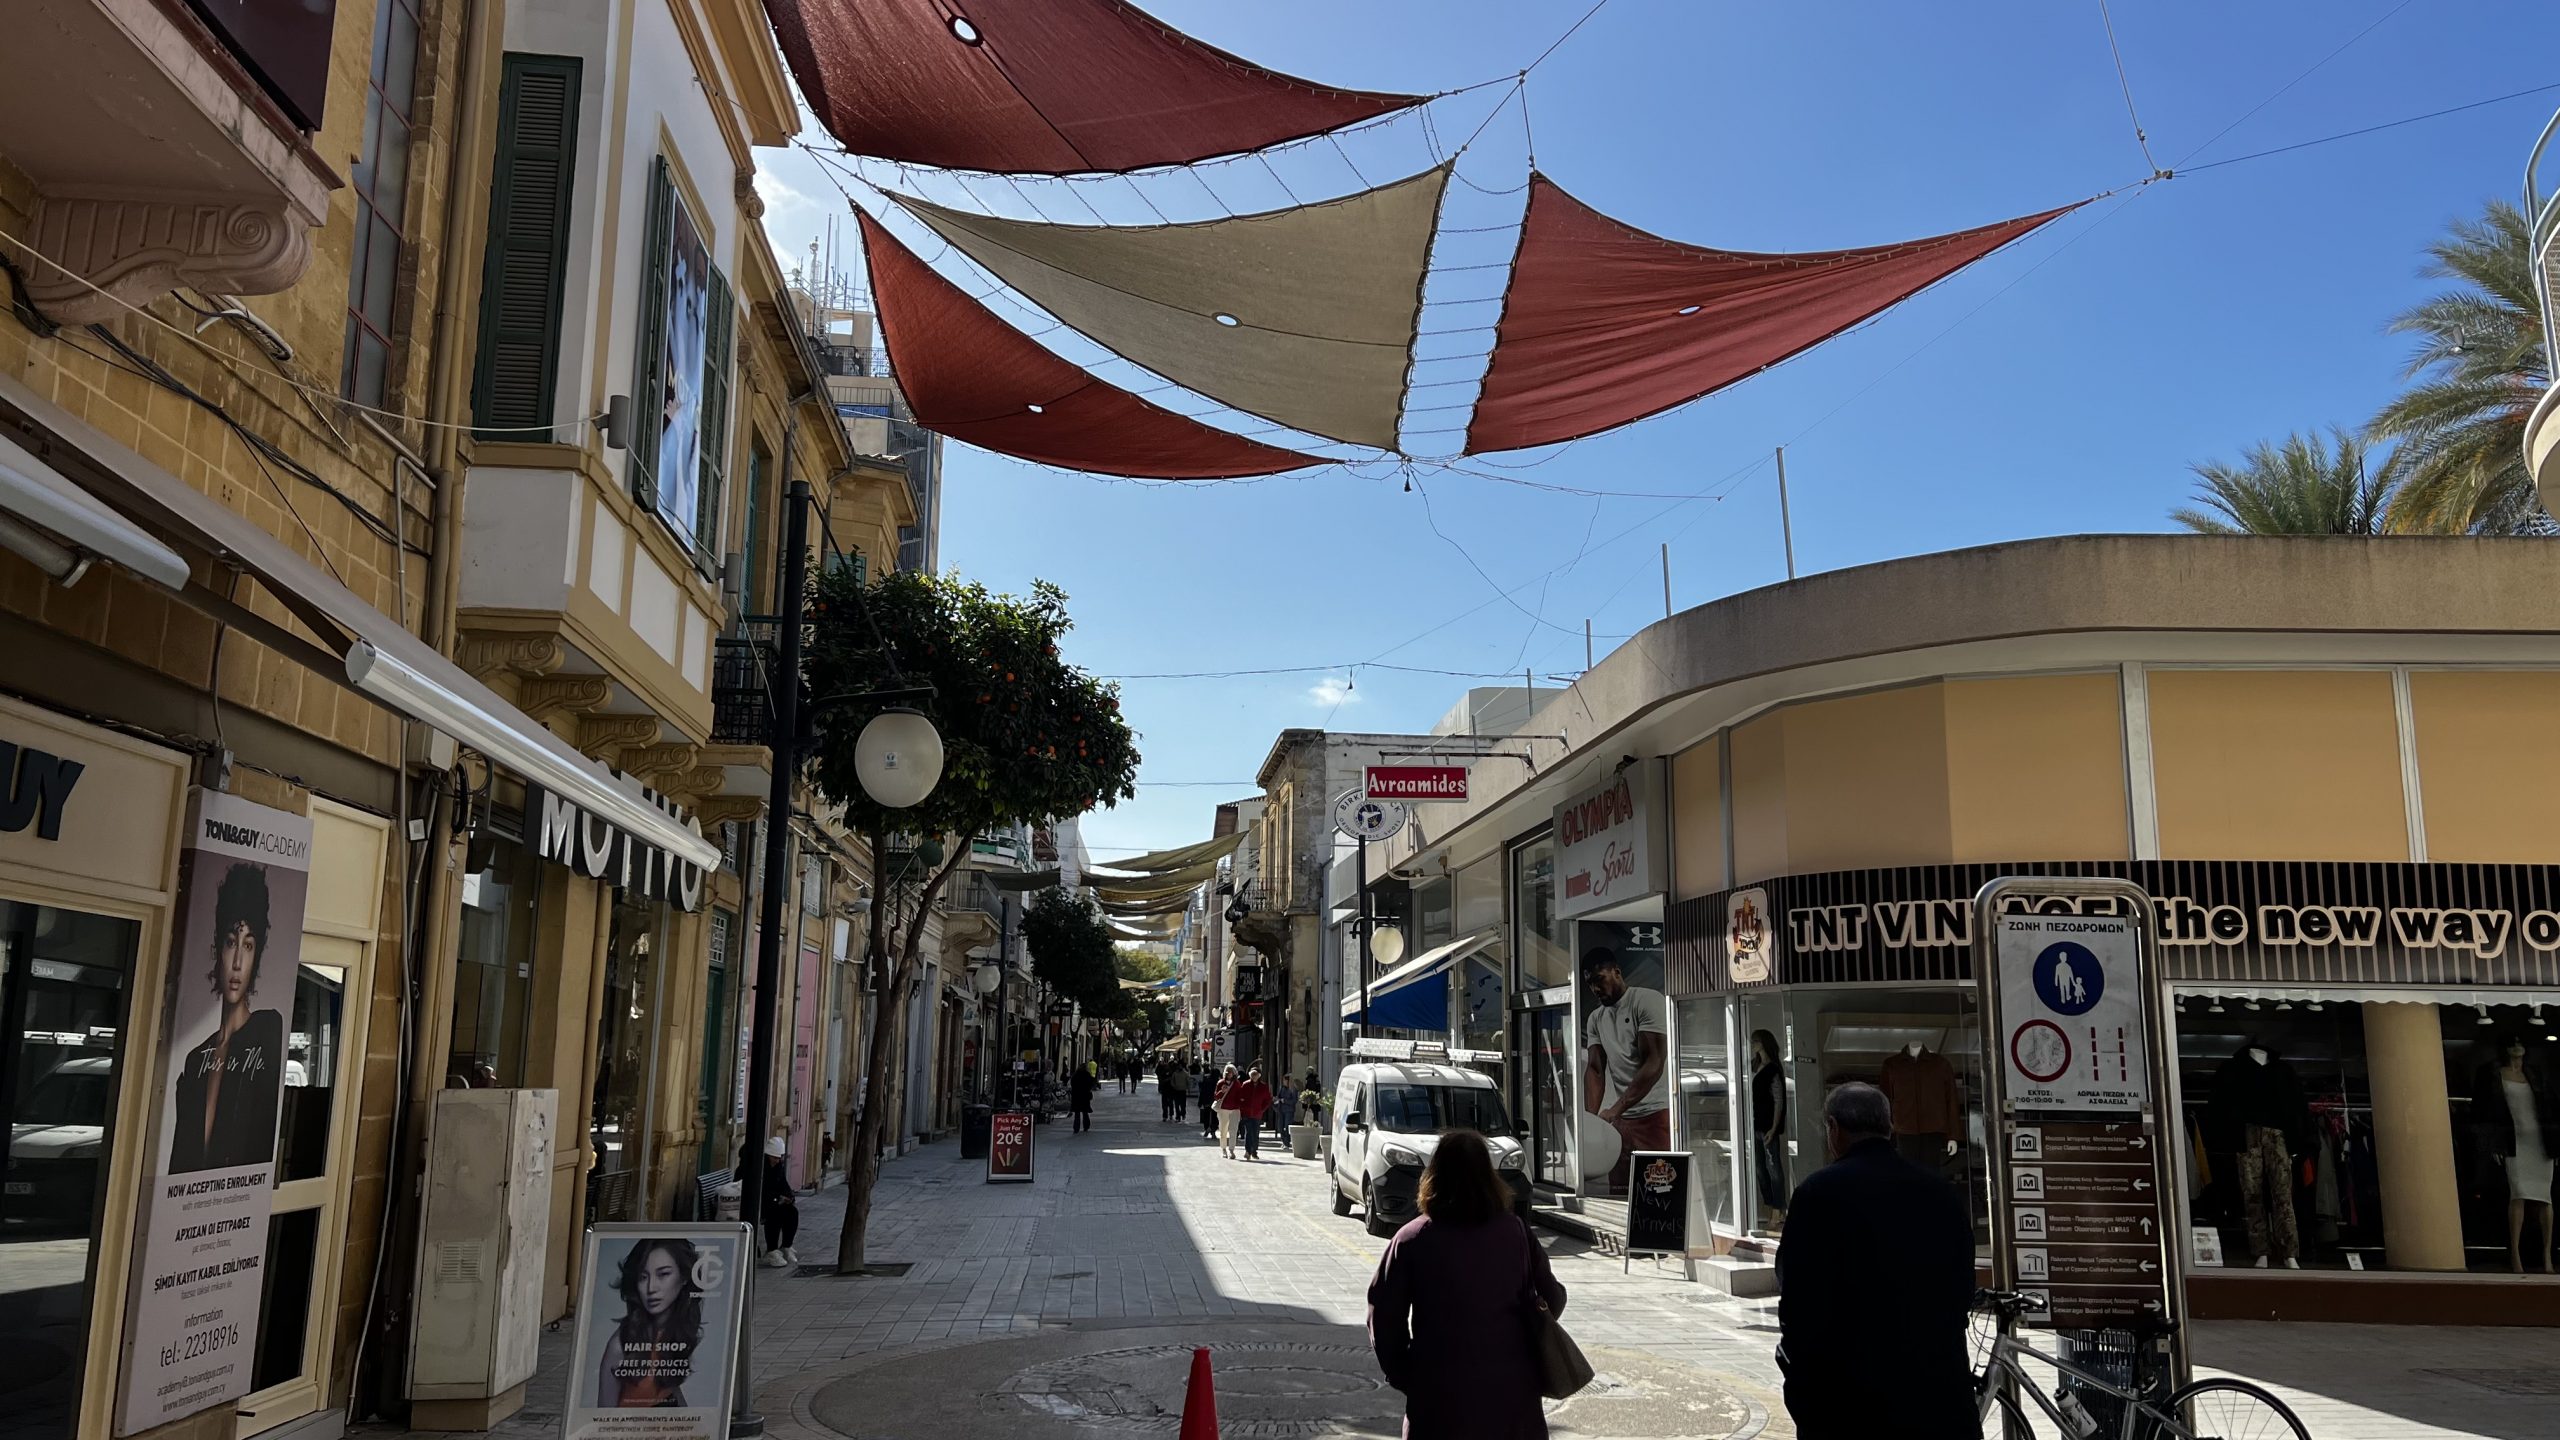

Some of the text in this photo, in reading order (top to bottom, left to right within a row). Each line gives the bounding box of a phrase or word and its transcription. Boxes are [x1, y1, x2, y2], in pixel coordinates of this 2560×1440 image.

[1368, 773, 1466, 793] Avraamides
[1562, 778, 1633, 847] OLYMPIA
[206, 818, 307, 859] TONI&GUY ACADEMY
[1593, 841, 1635, 896] Sports
[1790, 905, 1867, 952] TNT
[2154, 897, 2248, 945] the
[2258, 905, 2381, 946] new
[2391, 907, 2511, 958] way
[2009, 921, 2124, 933] ΖΩΝΗ ΠΕΖΟΔΡΟΜΩΝ
[198, 1045, 225, 1079] This
[227, 1056, 240, 1072] is
[1022, 1116, 1029, 1126] 3
[996, 1132, 1023, 1145] 20€
[167, 1173, 267, 1199] NOW ACCEPTING ENROLMENT
[1635, 1181, 1671, 1211] New
[198, 1264, 221, 1281] KABUL
[184, 1307, 224, 1329] information
[160, 1322, 239, 1368] tel: 22318916
[624, 1342, 687, 1352] HAIR SHOP
[614, 1368, 691, 1377] CONSULTATIONS
[619, 1359, 689, 1367] FREE PRODUCTS
